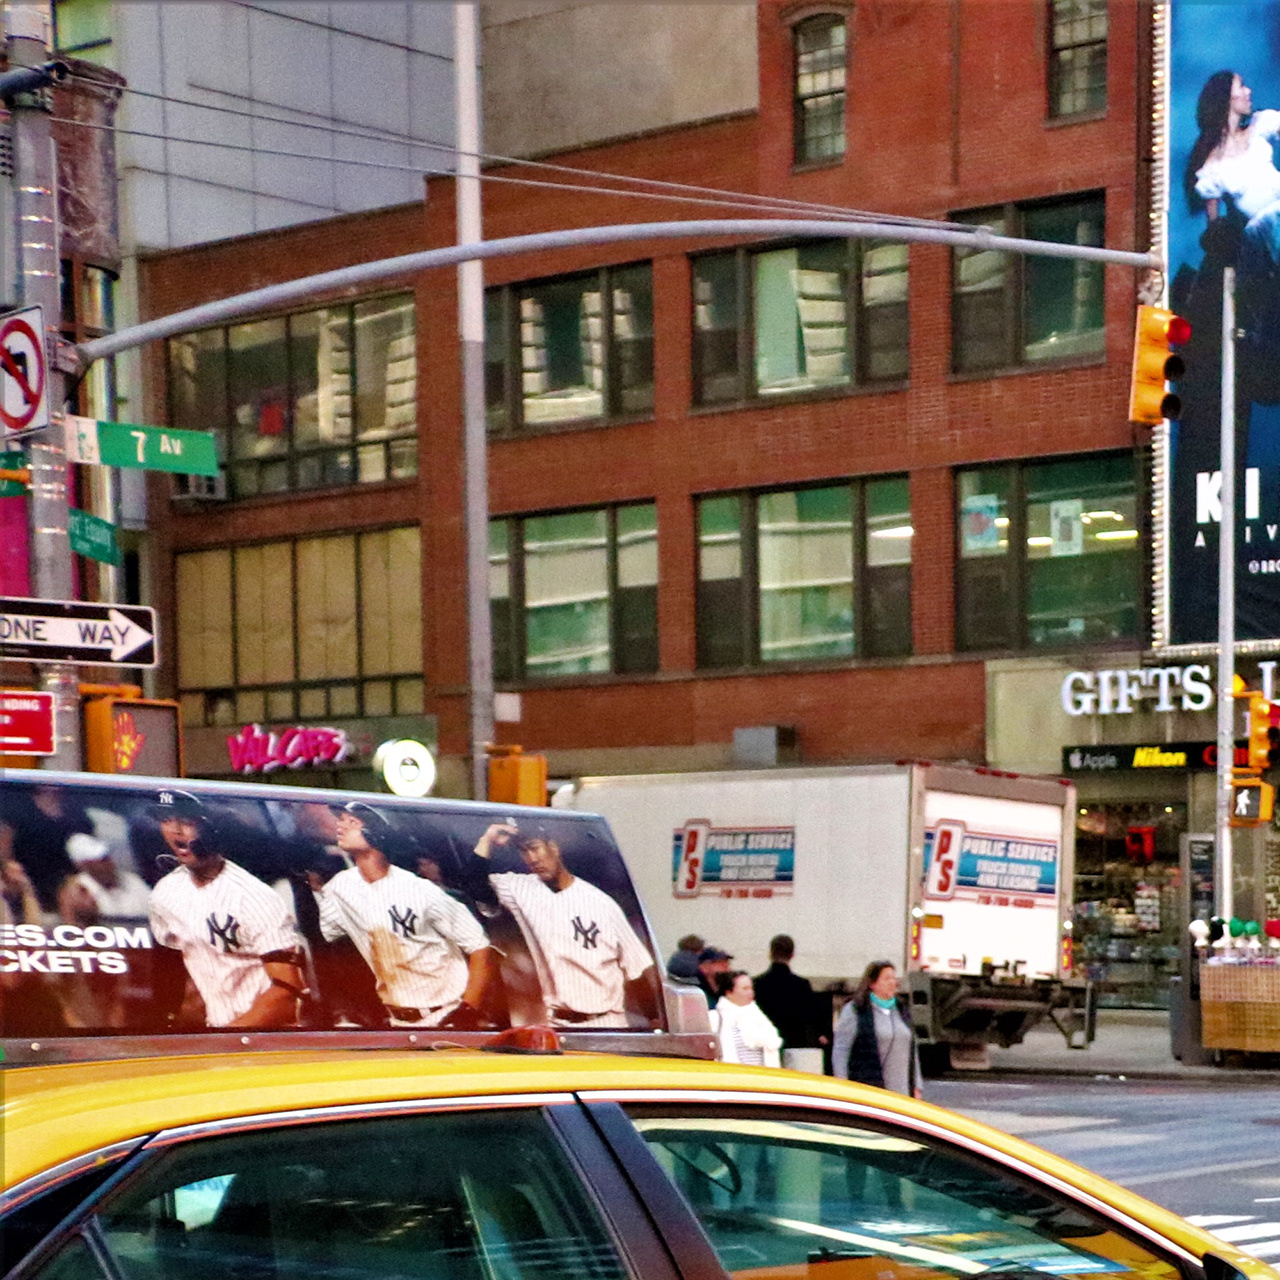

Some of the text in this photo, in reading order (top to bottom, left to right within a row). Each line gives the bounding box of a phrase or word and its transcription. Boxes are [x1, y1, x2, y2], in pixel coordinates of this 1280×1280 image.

[130, 431, 147, 463] 7
[0, 618, 130, 645] ONE WAY
[1061, 664, 1213, 716] GIFTS
[1132, 747, 1187, 768] Nikon
[963, 838, 1056, 862] PUBLIC SERVICE
